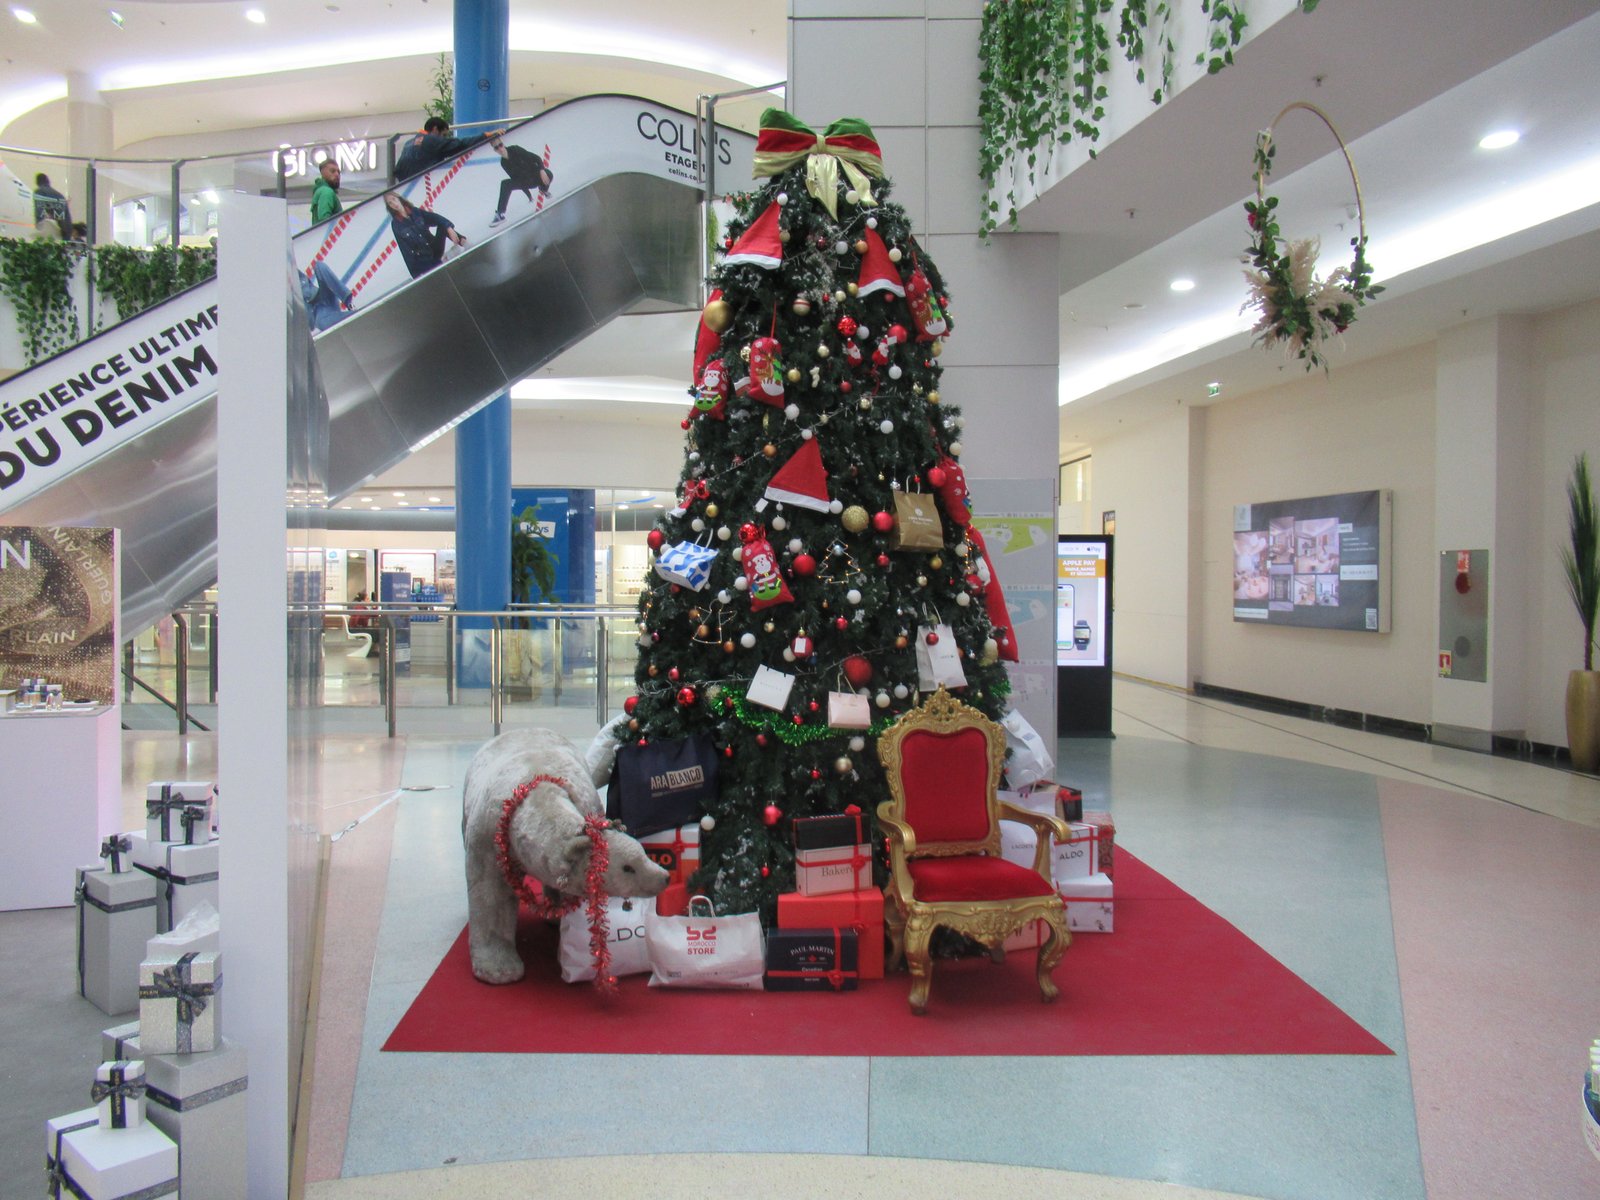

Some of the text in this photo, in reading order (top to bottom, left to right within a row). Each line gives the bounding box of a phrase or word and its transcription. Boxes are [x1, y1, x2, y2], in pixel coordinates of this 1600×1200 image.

[664, 151, 698, 171] ETAGE
[0, 353, 132, 433] ÉRIENCE
[61, 344, 218, 447] DENIM
[650, 767, 702, 790] ARA BLANCO
[1059, 850, 1084, 861] ALDO
[687, 947, 716, 956] STORE
[790, 945, 835, 956] PAUL MARTIN
